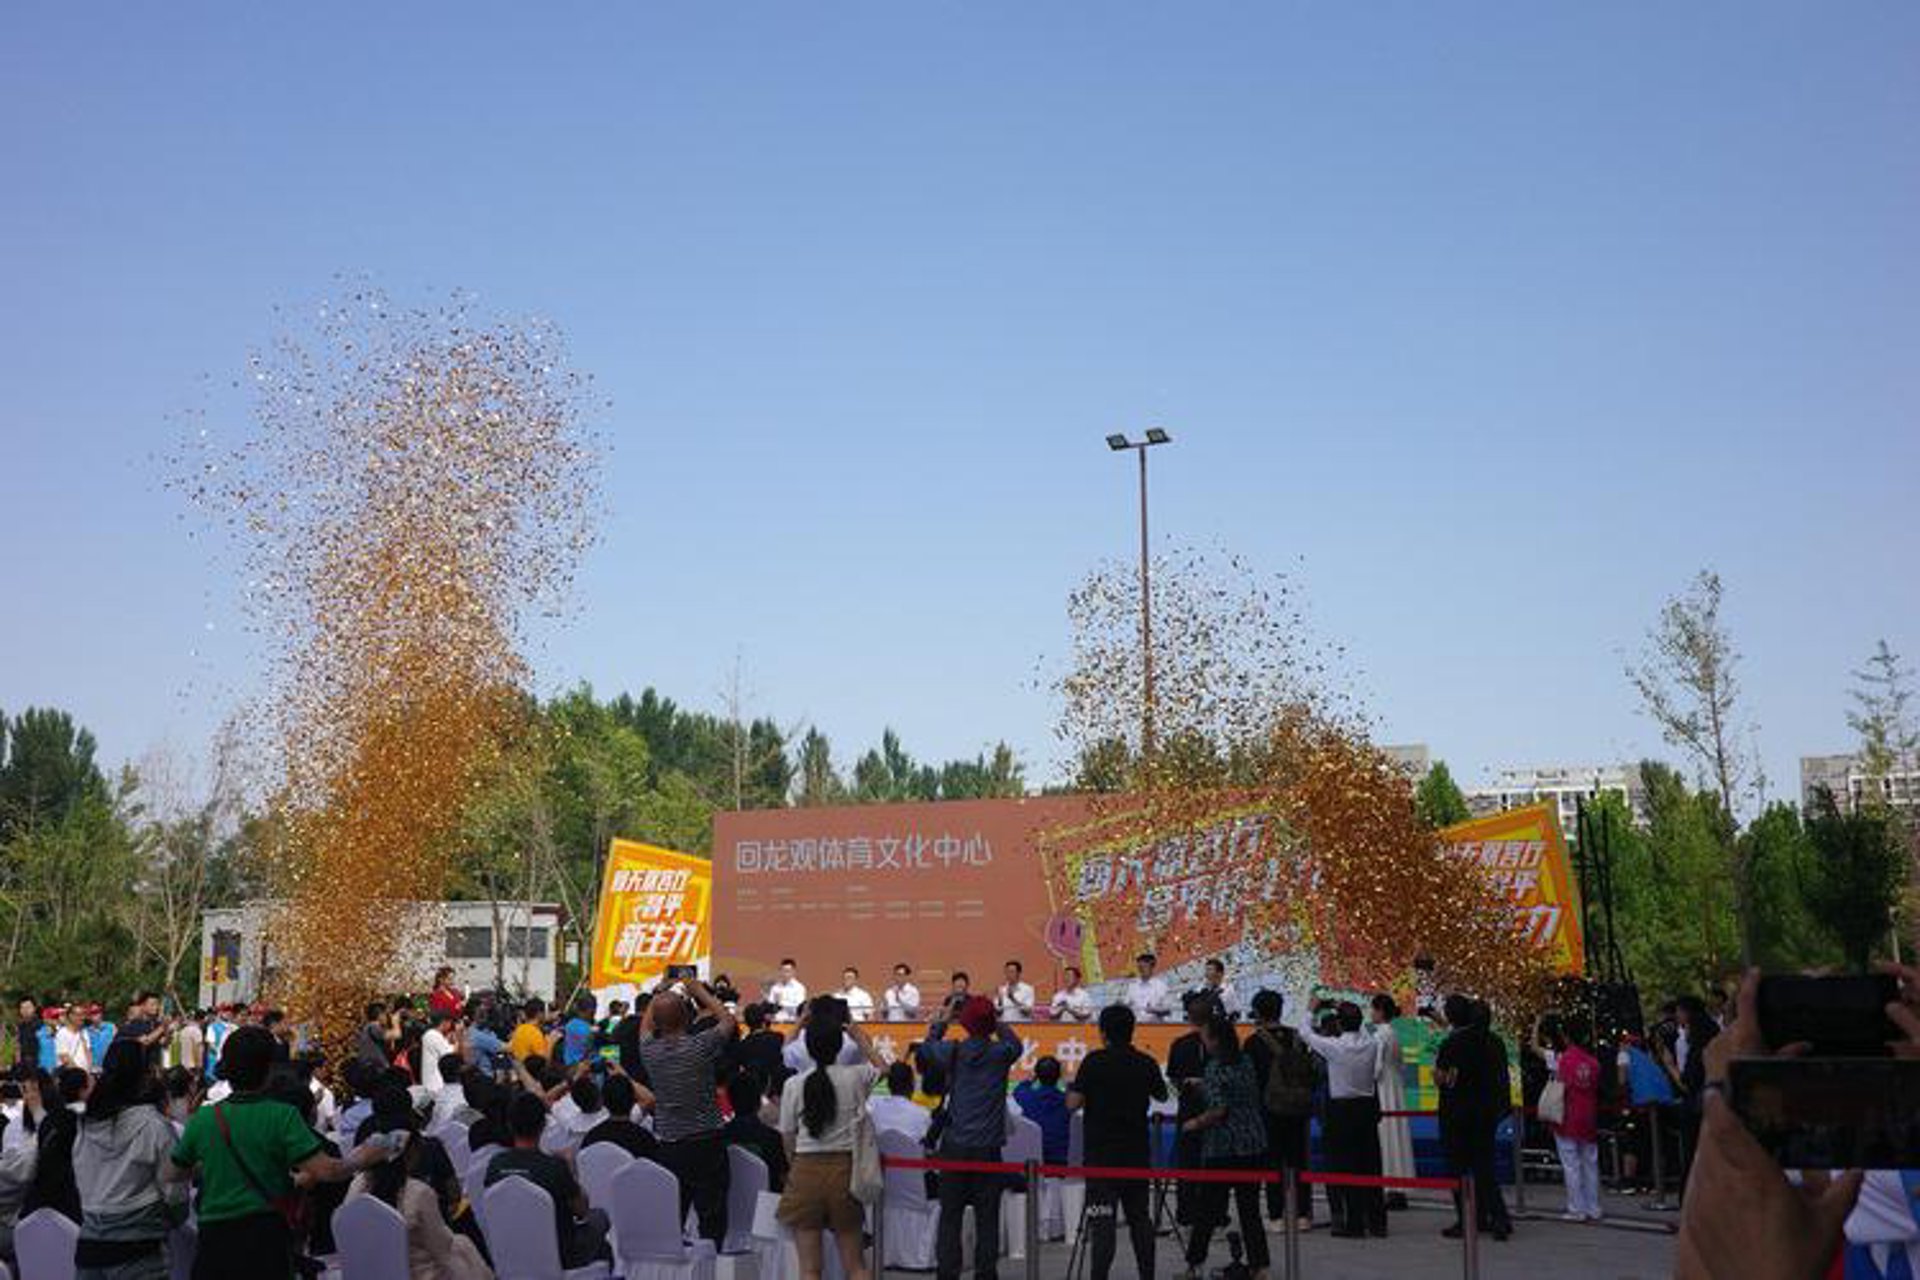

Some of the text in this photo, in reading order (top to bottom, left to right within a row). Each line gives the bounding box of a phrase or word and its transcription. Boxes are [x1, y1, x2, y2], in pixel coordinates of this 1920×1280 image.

[736, 831, 994, 874] 回龙观体育文化中心
